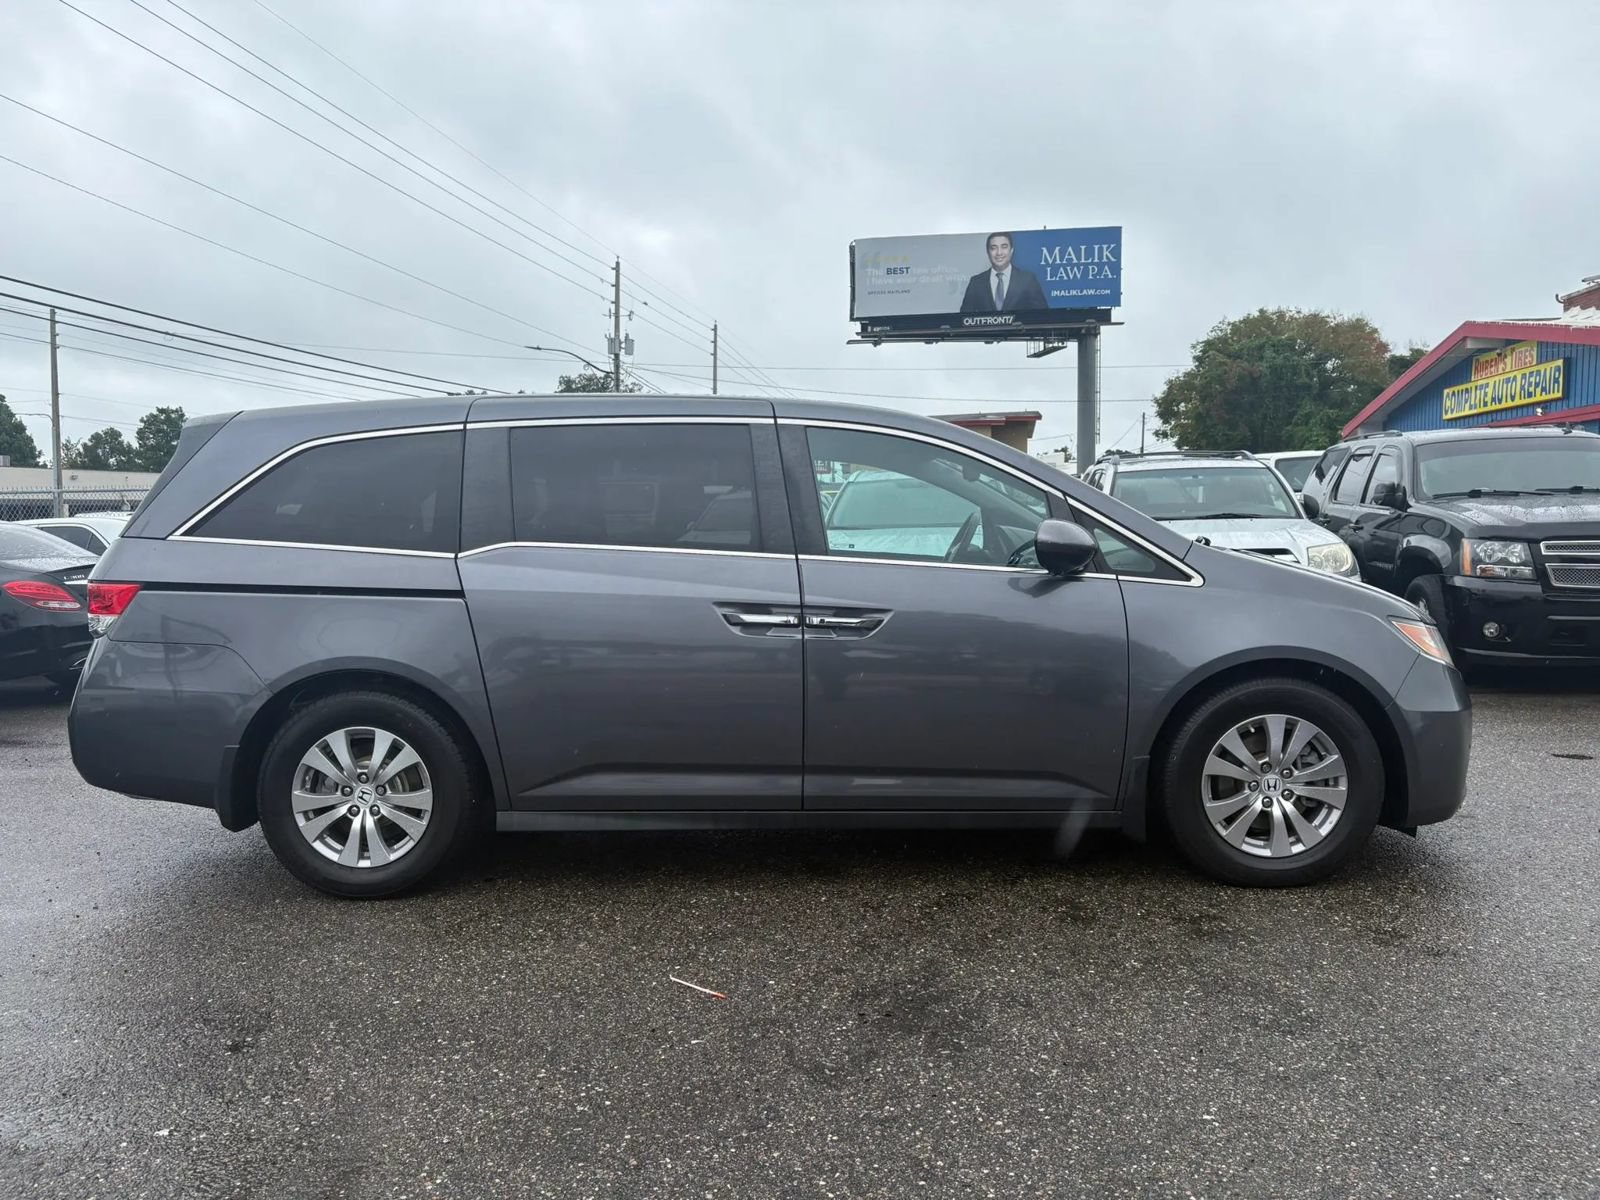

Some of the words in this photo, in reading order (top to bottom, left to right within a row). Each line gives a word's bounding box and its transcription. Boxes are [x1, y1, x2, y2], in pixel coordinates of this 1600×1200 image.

[1040, 244, 1117, 265] MALIK
[886, 267, 911, 275] BEST
[1046, 265, 1084, 281] LAW
[1088, 264, 1117, 280] P.A.
[1510, 347, 1535, 370] TIRES
[1443, 382, 1489, 416] COMPLETE
[1490, 374, 1518, 406] AUTO
[1519, 365, 1562, 400] REPAIR
